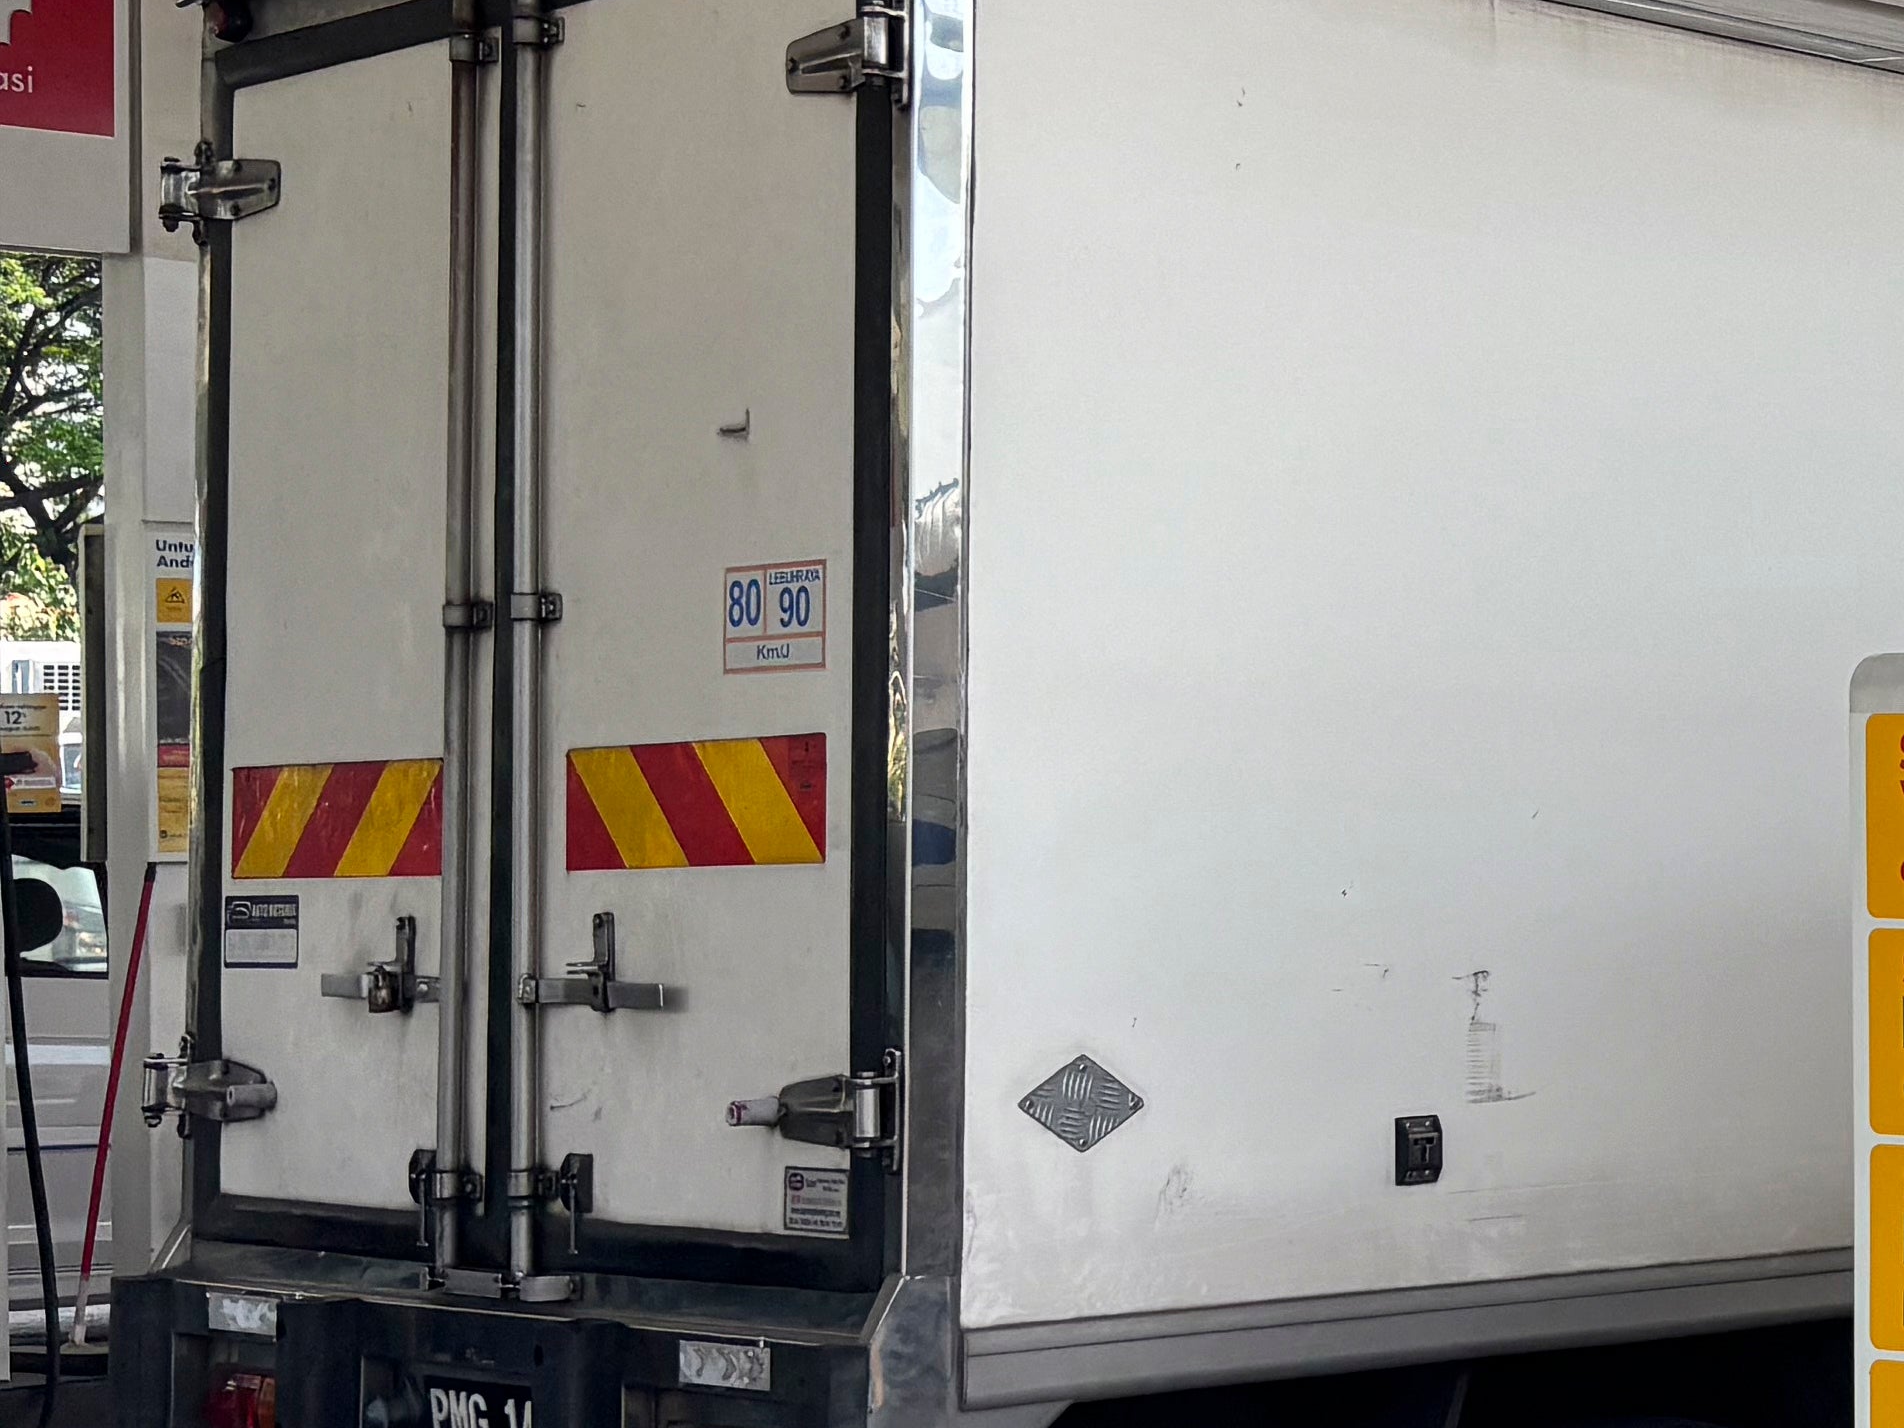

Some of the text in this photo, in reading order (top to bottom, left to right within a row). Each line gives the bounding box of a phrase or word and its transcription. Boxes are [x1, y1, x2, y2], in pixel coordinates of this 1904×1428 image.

[156, 540, 193, 552] Untu
[728, 579, 810, 628] 80 90
